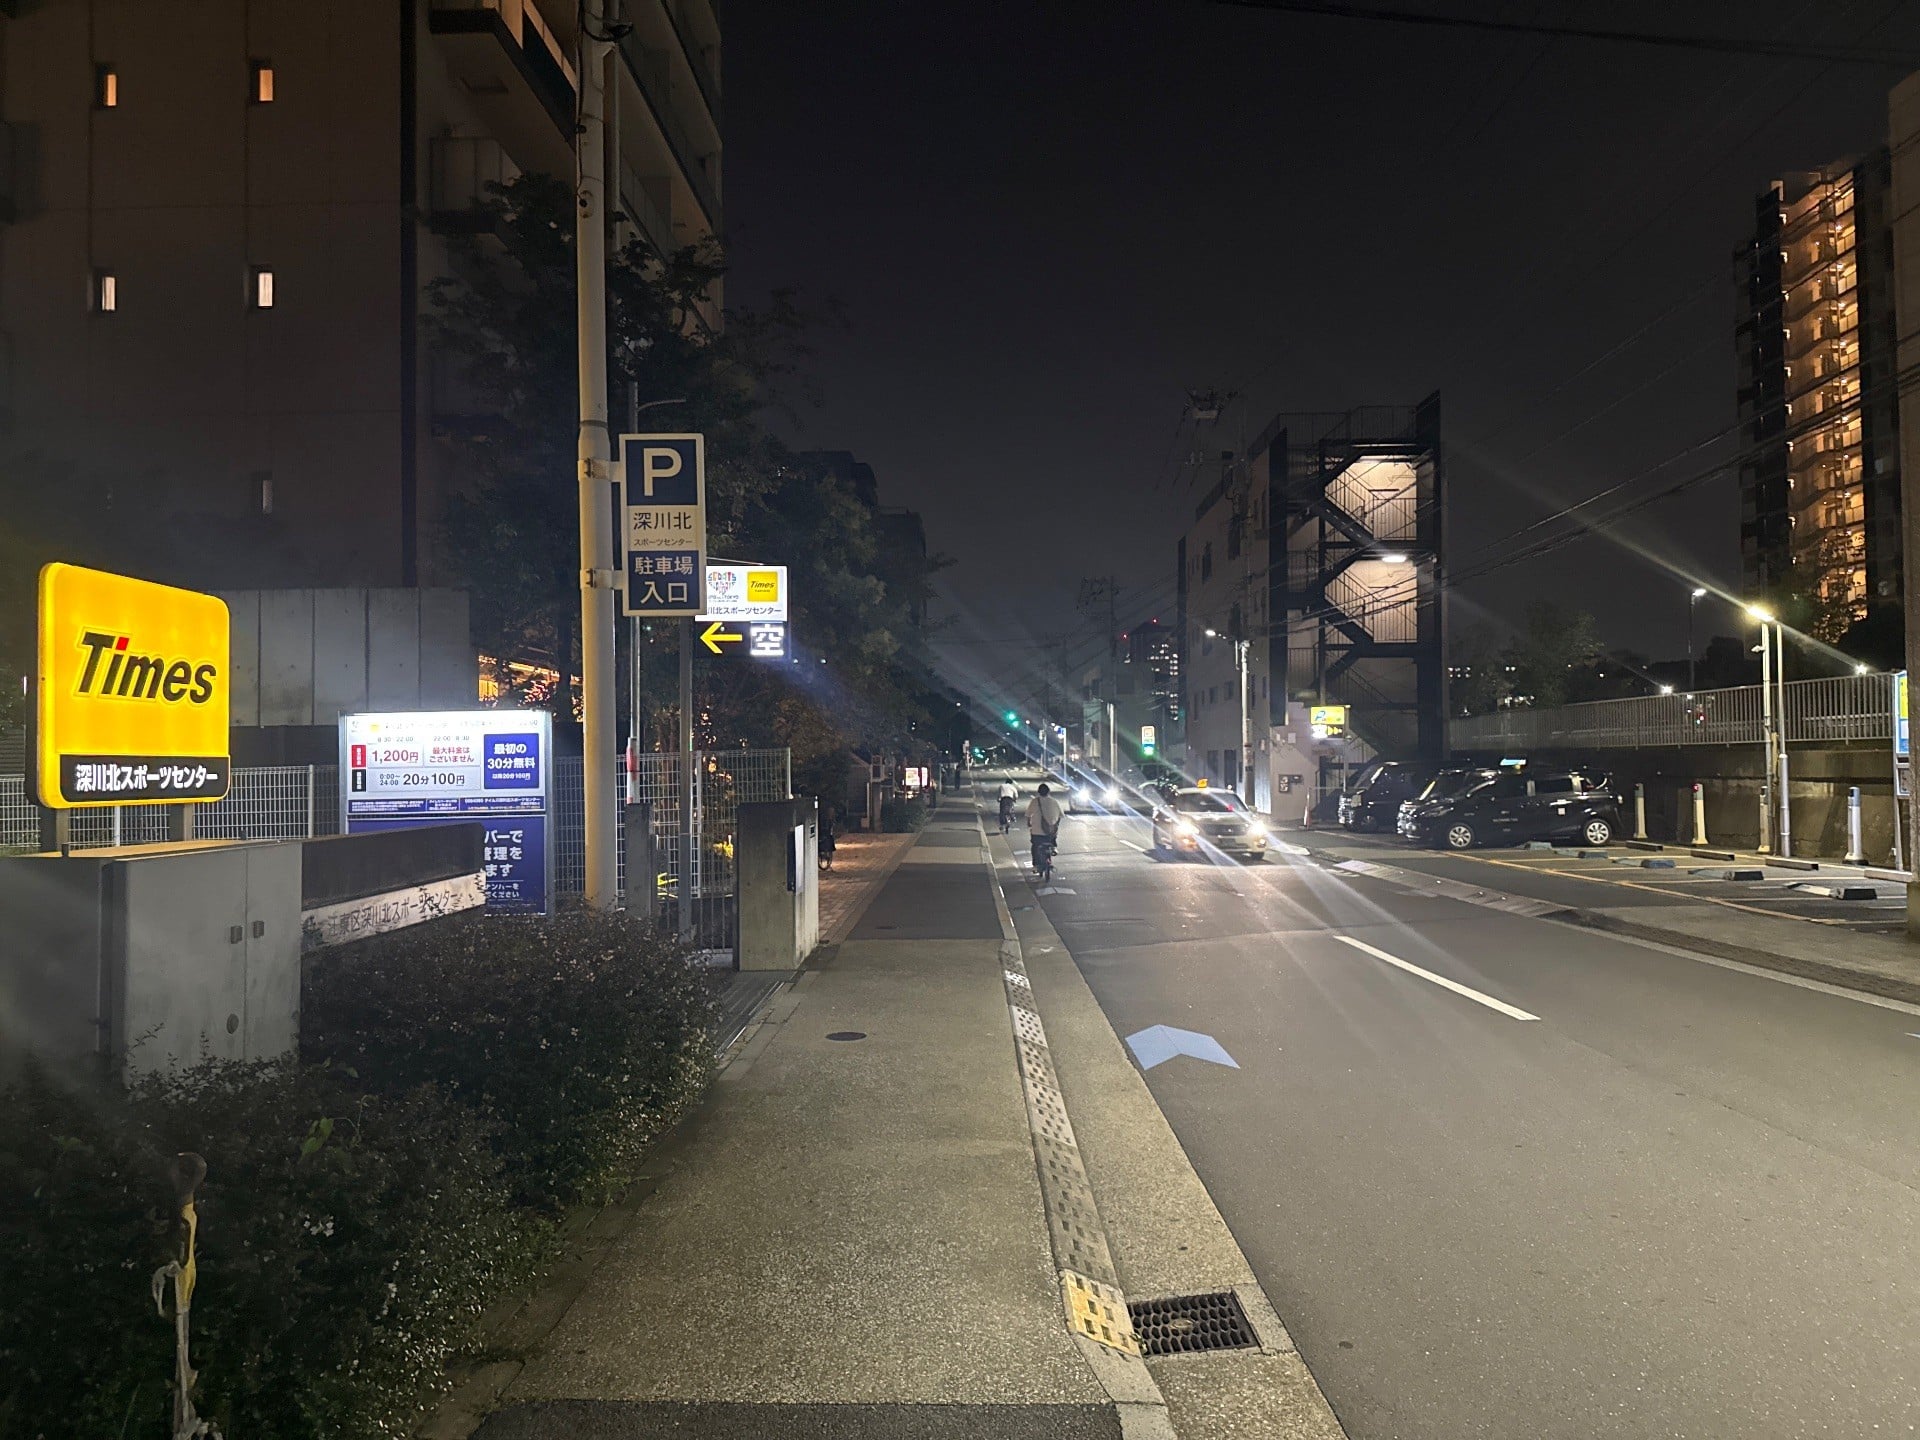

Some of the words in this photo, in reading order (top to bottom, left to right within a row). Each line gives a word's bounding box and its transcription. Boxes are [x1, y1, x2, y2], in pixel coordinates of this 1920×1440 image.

[643, 447, 682, 497] P
[633, 511, 693, 530] 深川北
[633, 537, 693, 546] スポーツセンター
[634, 556, 693, 575] 駐車場
[640, 580, 688, 604] 入口
[750, 580, 775, 589] Times
[750, 623, 784, 656] 空
[78, 631, 217, 704] Times
[371, 749, 419, 763] 1,200円
[493, 743, 527, 755] 最初の
[429, 755, 475, 763] ございません
[487, 756, 536, 770] 30分無料
[76, 763, 218, 792] 深川北スポーツセンター
[431, 772, 465, 787] 100円
[485, 863, 513, 877] ます
